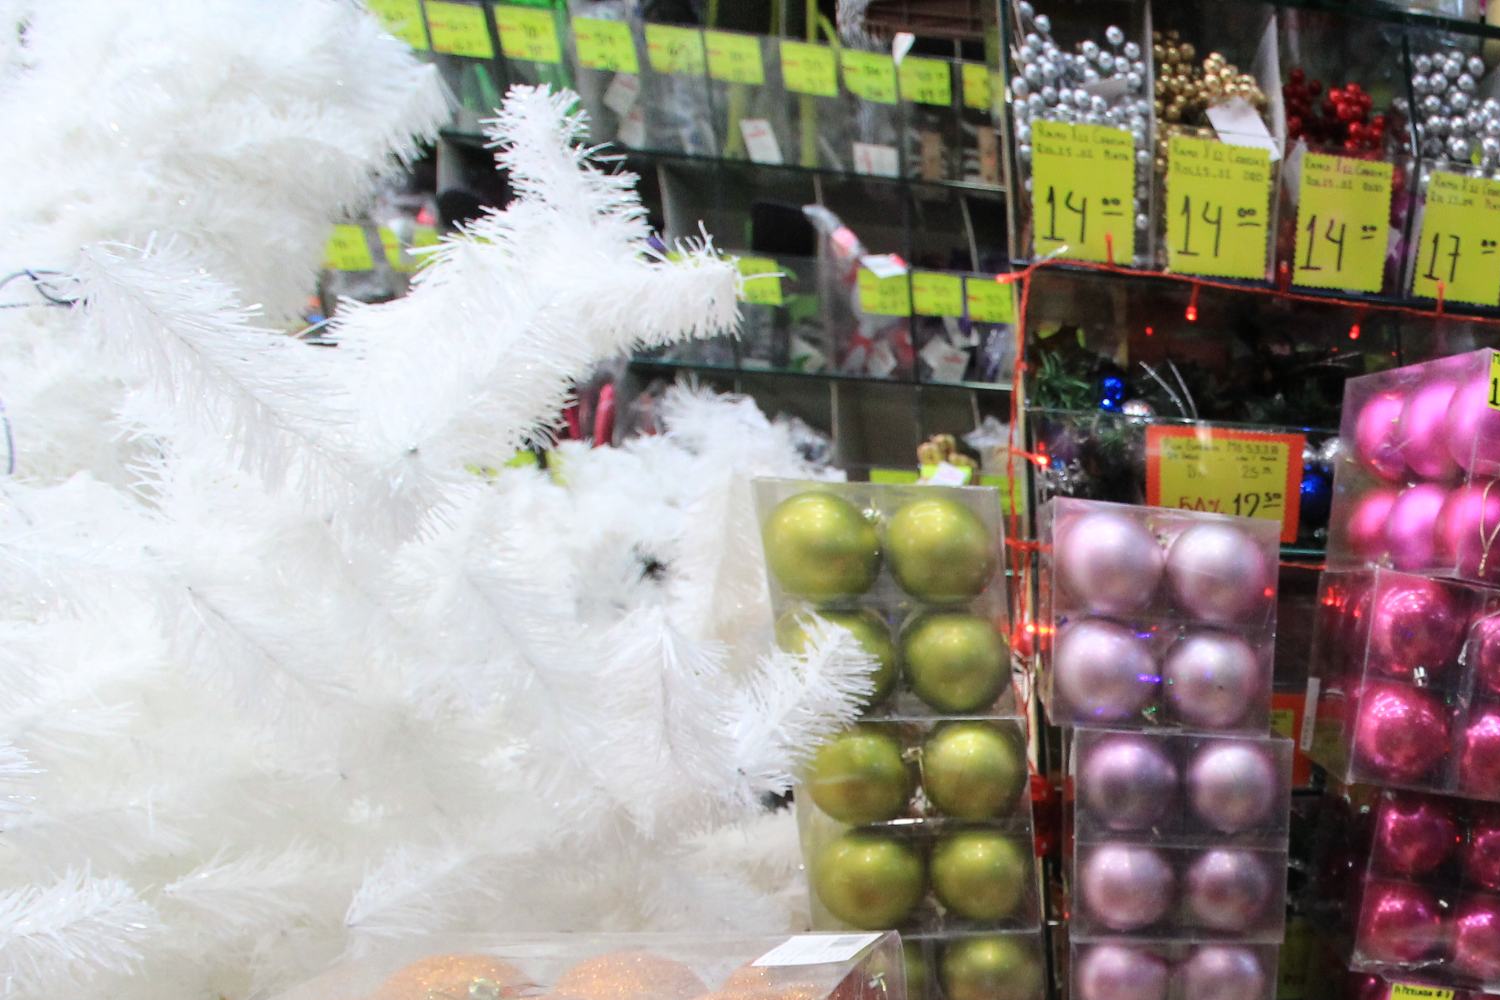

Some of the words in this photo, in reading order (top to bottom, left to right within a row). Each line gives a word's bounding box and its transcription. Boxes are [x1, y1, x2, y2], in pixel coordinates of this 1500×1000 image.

[1042, 185, 1087, 243] 14
[1177, 195, 1222, 257] 14
[1299, 215, 1346, 271] 14
[1423, 233, 1460, 283] 17
